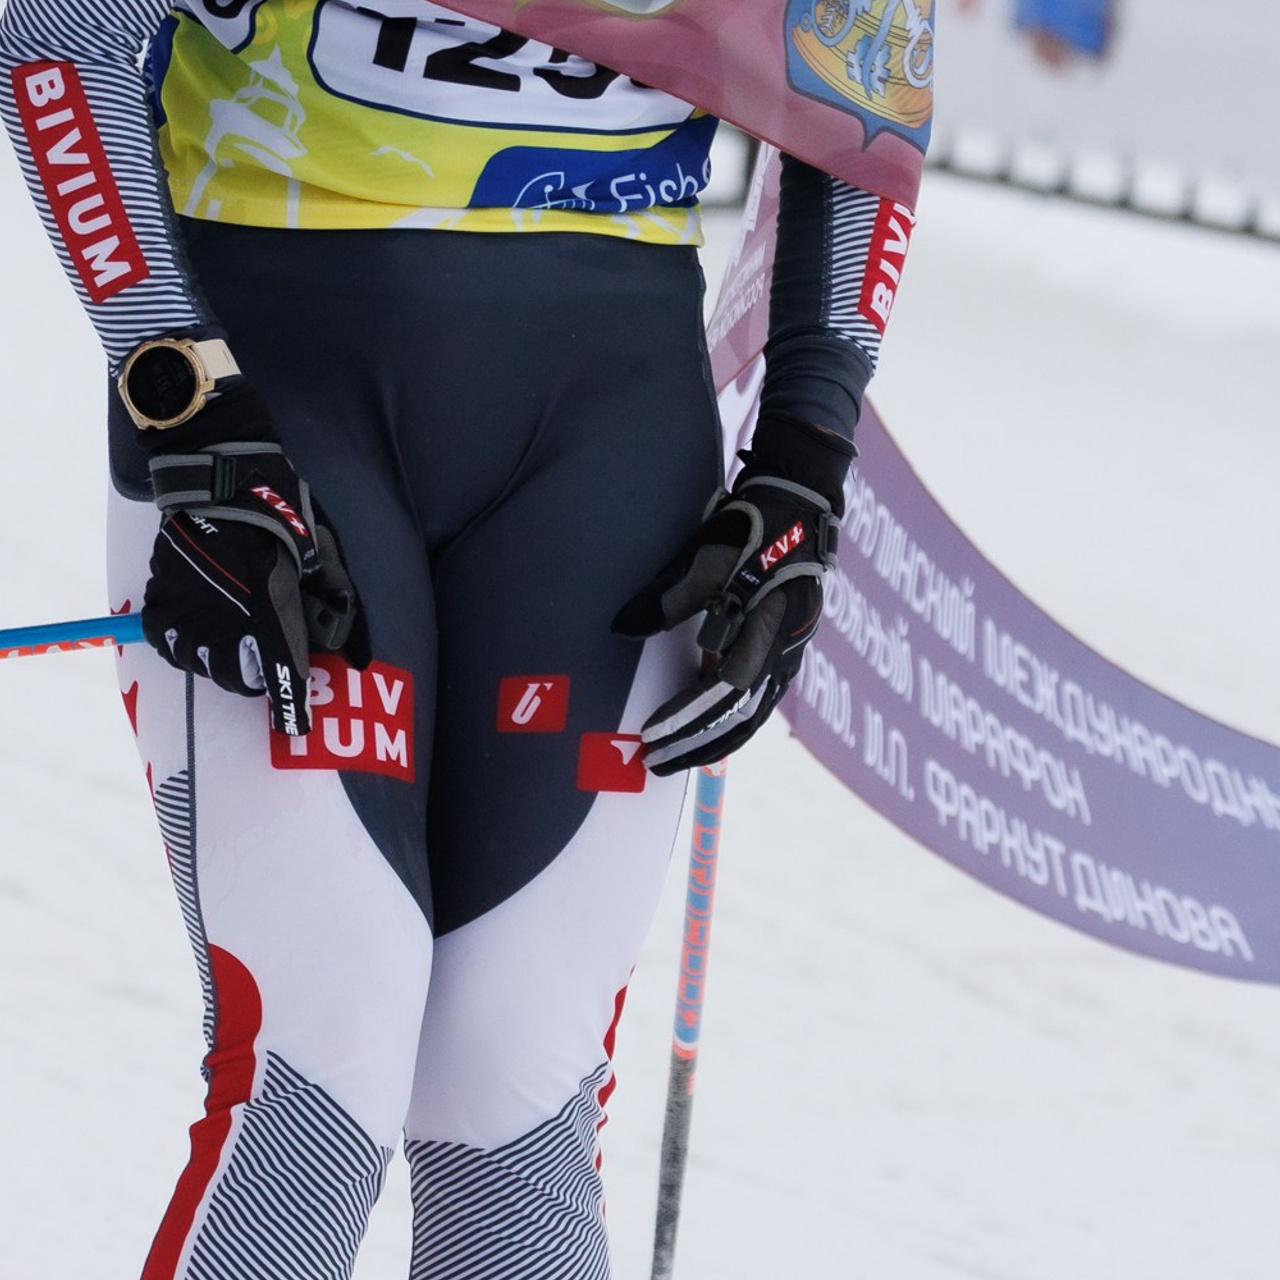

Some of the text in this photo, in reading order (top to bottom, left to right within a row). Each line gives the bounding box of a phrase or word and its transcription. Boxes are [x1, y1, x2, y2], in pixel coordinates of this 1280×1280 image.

[356, 5, 656, 100] 125
[24, 66, 133, 289] BIVIUM
[870, 201, 918, 324] BIVI
[275, 662, 300, 736] SKI TIME
[920, 656, 1092, 826] МАРАФОН
